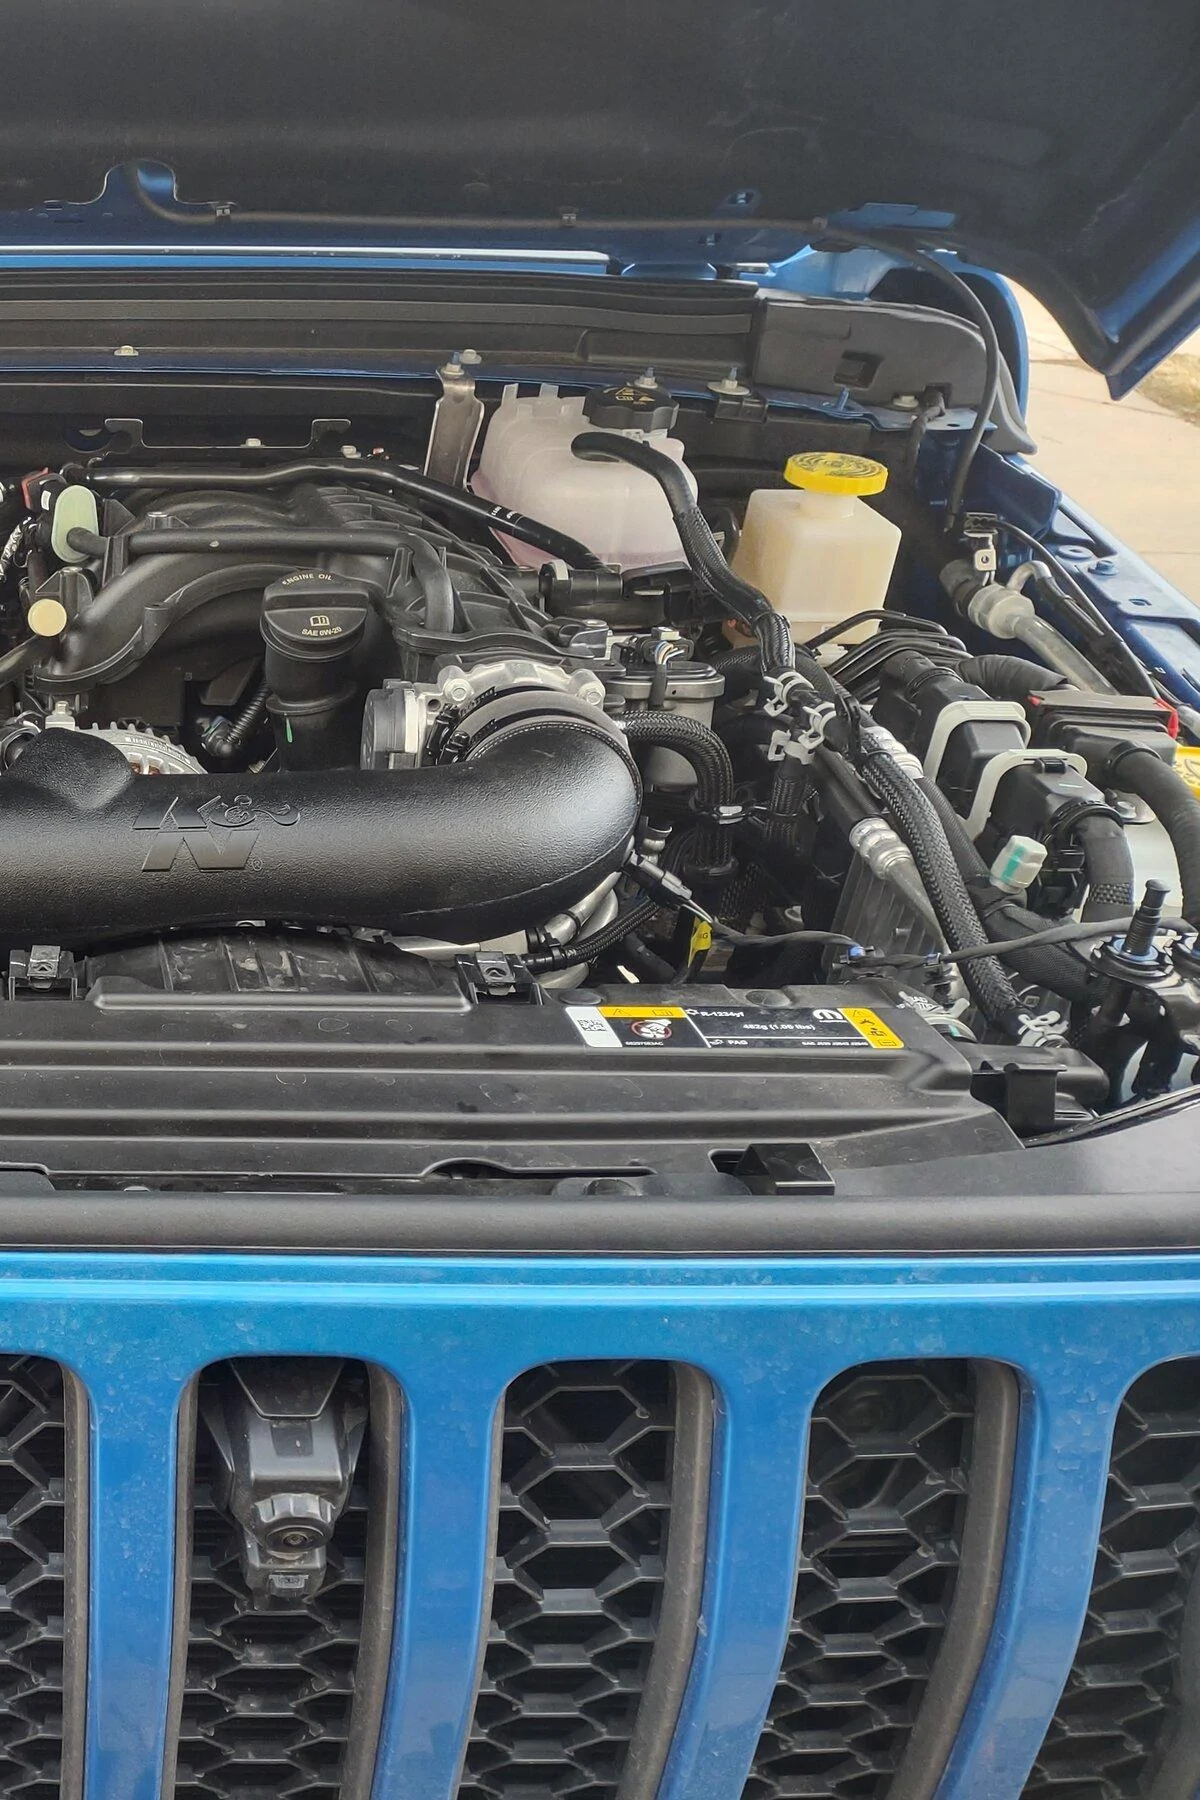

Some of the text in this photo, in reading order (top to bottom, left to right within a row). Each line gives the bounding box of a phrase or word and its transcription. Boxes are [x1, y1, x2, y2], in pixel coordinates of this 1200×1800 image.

[282, 573, 333, 585] ENGINE OIL
[301, 626, 342, 637] SAE 0W-20
